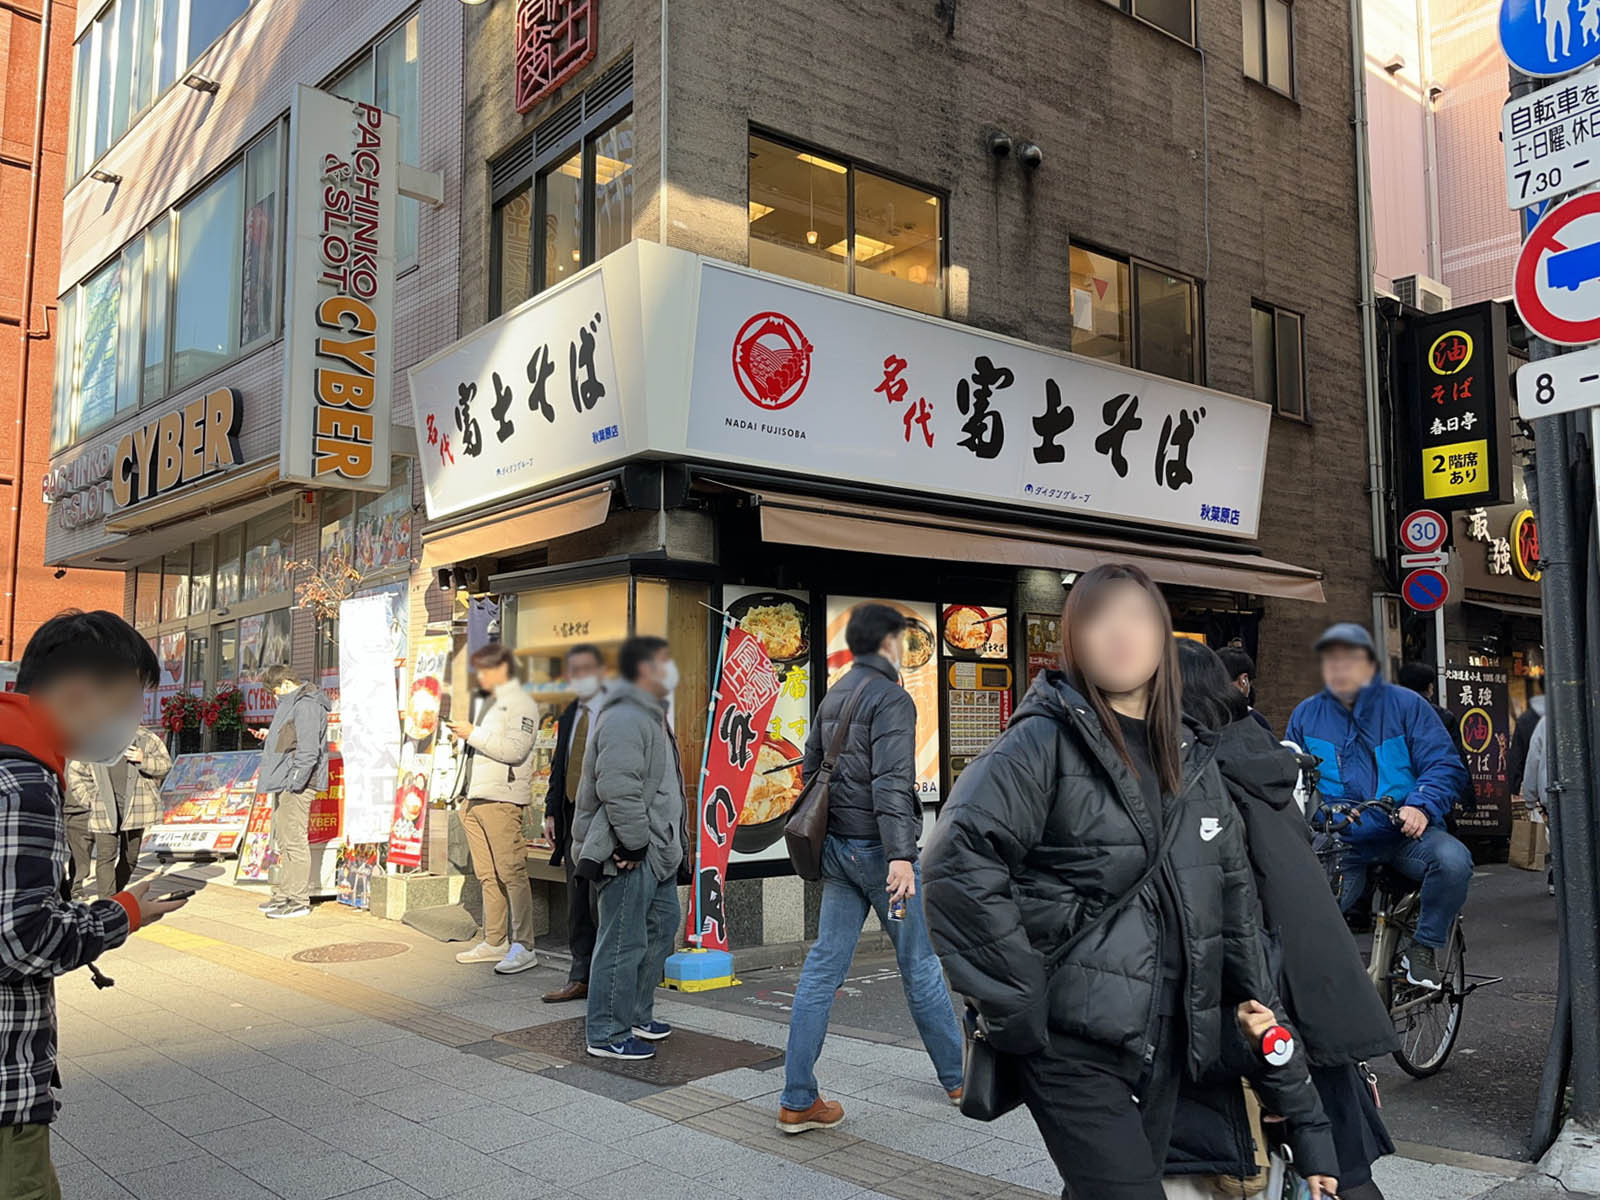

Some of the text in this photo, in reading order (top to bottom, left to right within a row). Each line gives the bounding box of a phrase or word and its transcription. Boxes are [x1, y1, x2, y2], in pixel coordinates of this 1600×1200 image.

[1511, 85, 1600, 135] 自転車を
[355, 101, 383, 298] PACHINKO
[322, 185, 351, 292] SLOT
[314, 295, 378, 479] CYBER
[1431, 377, 1474, 404] そば
[1535, 373, 1555, 405] 8
[725, 417, 807, 440] NADAI FUJISOBA
[1429, 411, 1478, 436] 春日亭
[112, 386, 236, 508] CYBER
[1449, 468, 1478, 486] あり
[1200, 503, 1241, 526] 秋葉原店
[1411, 521, 1438, 542] 30
[1459, 685, 1493, 706] 最強
[308, 817, 338, 834] YBER
